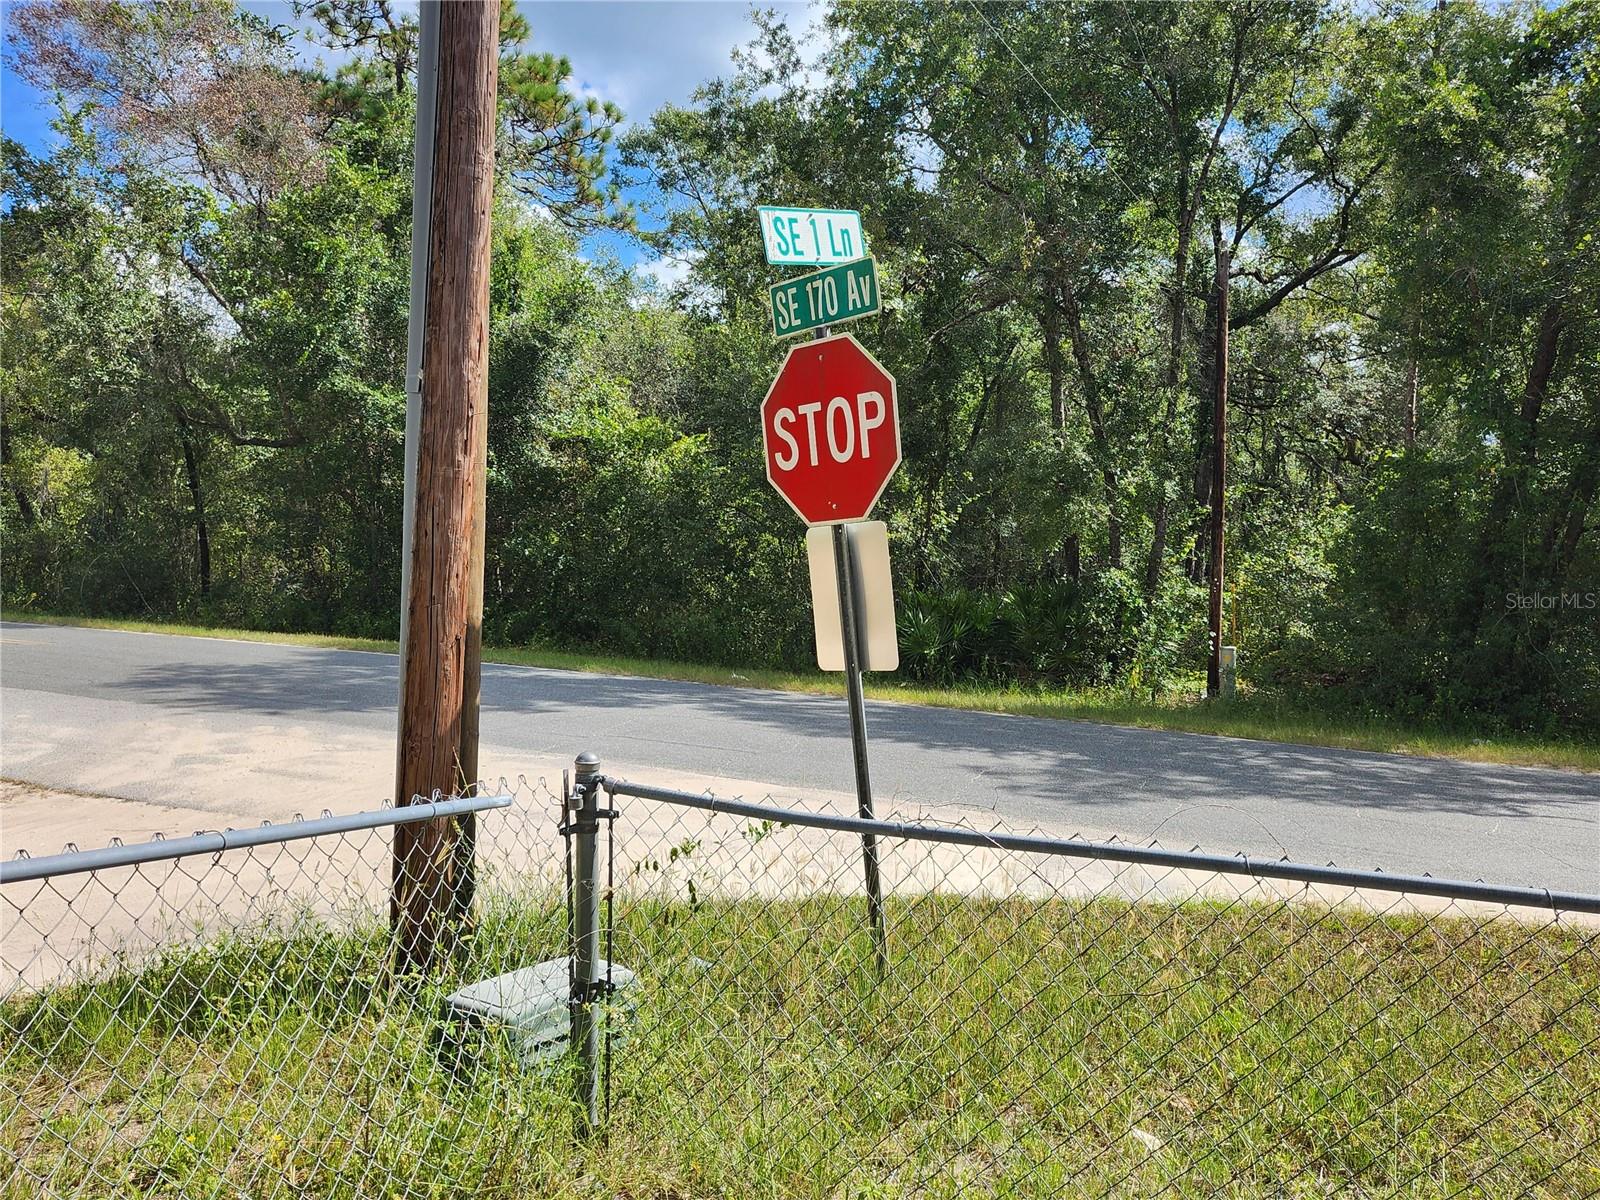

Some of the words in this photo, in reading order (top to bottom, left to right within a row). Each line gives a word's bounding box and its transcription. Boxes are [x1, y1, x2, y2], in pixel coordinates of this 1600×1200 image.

[772, 216, 804, 256] SE
[809, 218, 821, 256] 1
[827, 219, 853, 256] Ln
[775, 287, 801, 330] SE
[805, 276, 838, 321] 170
[846, 270, 870, 311] Av
[773, 390, 886, 471] STOP
